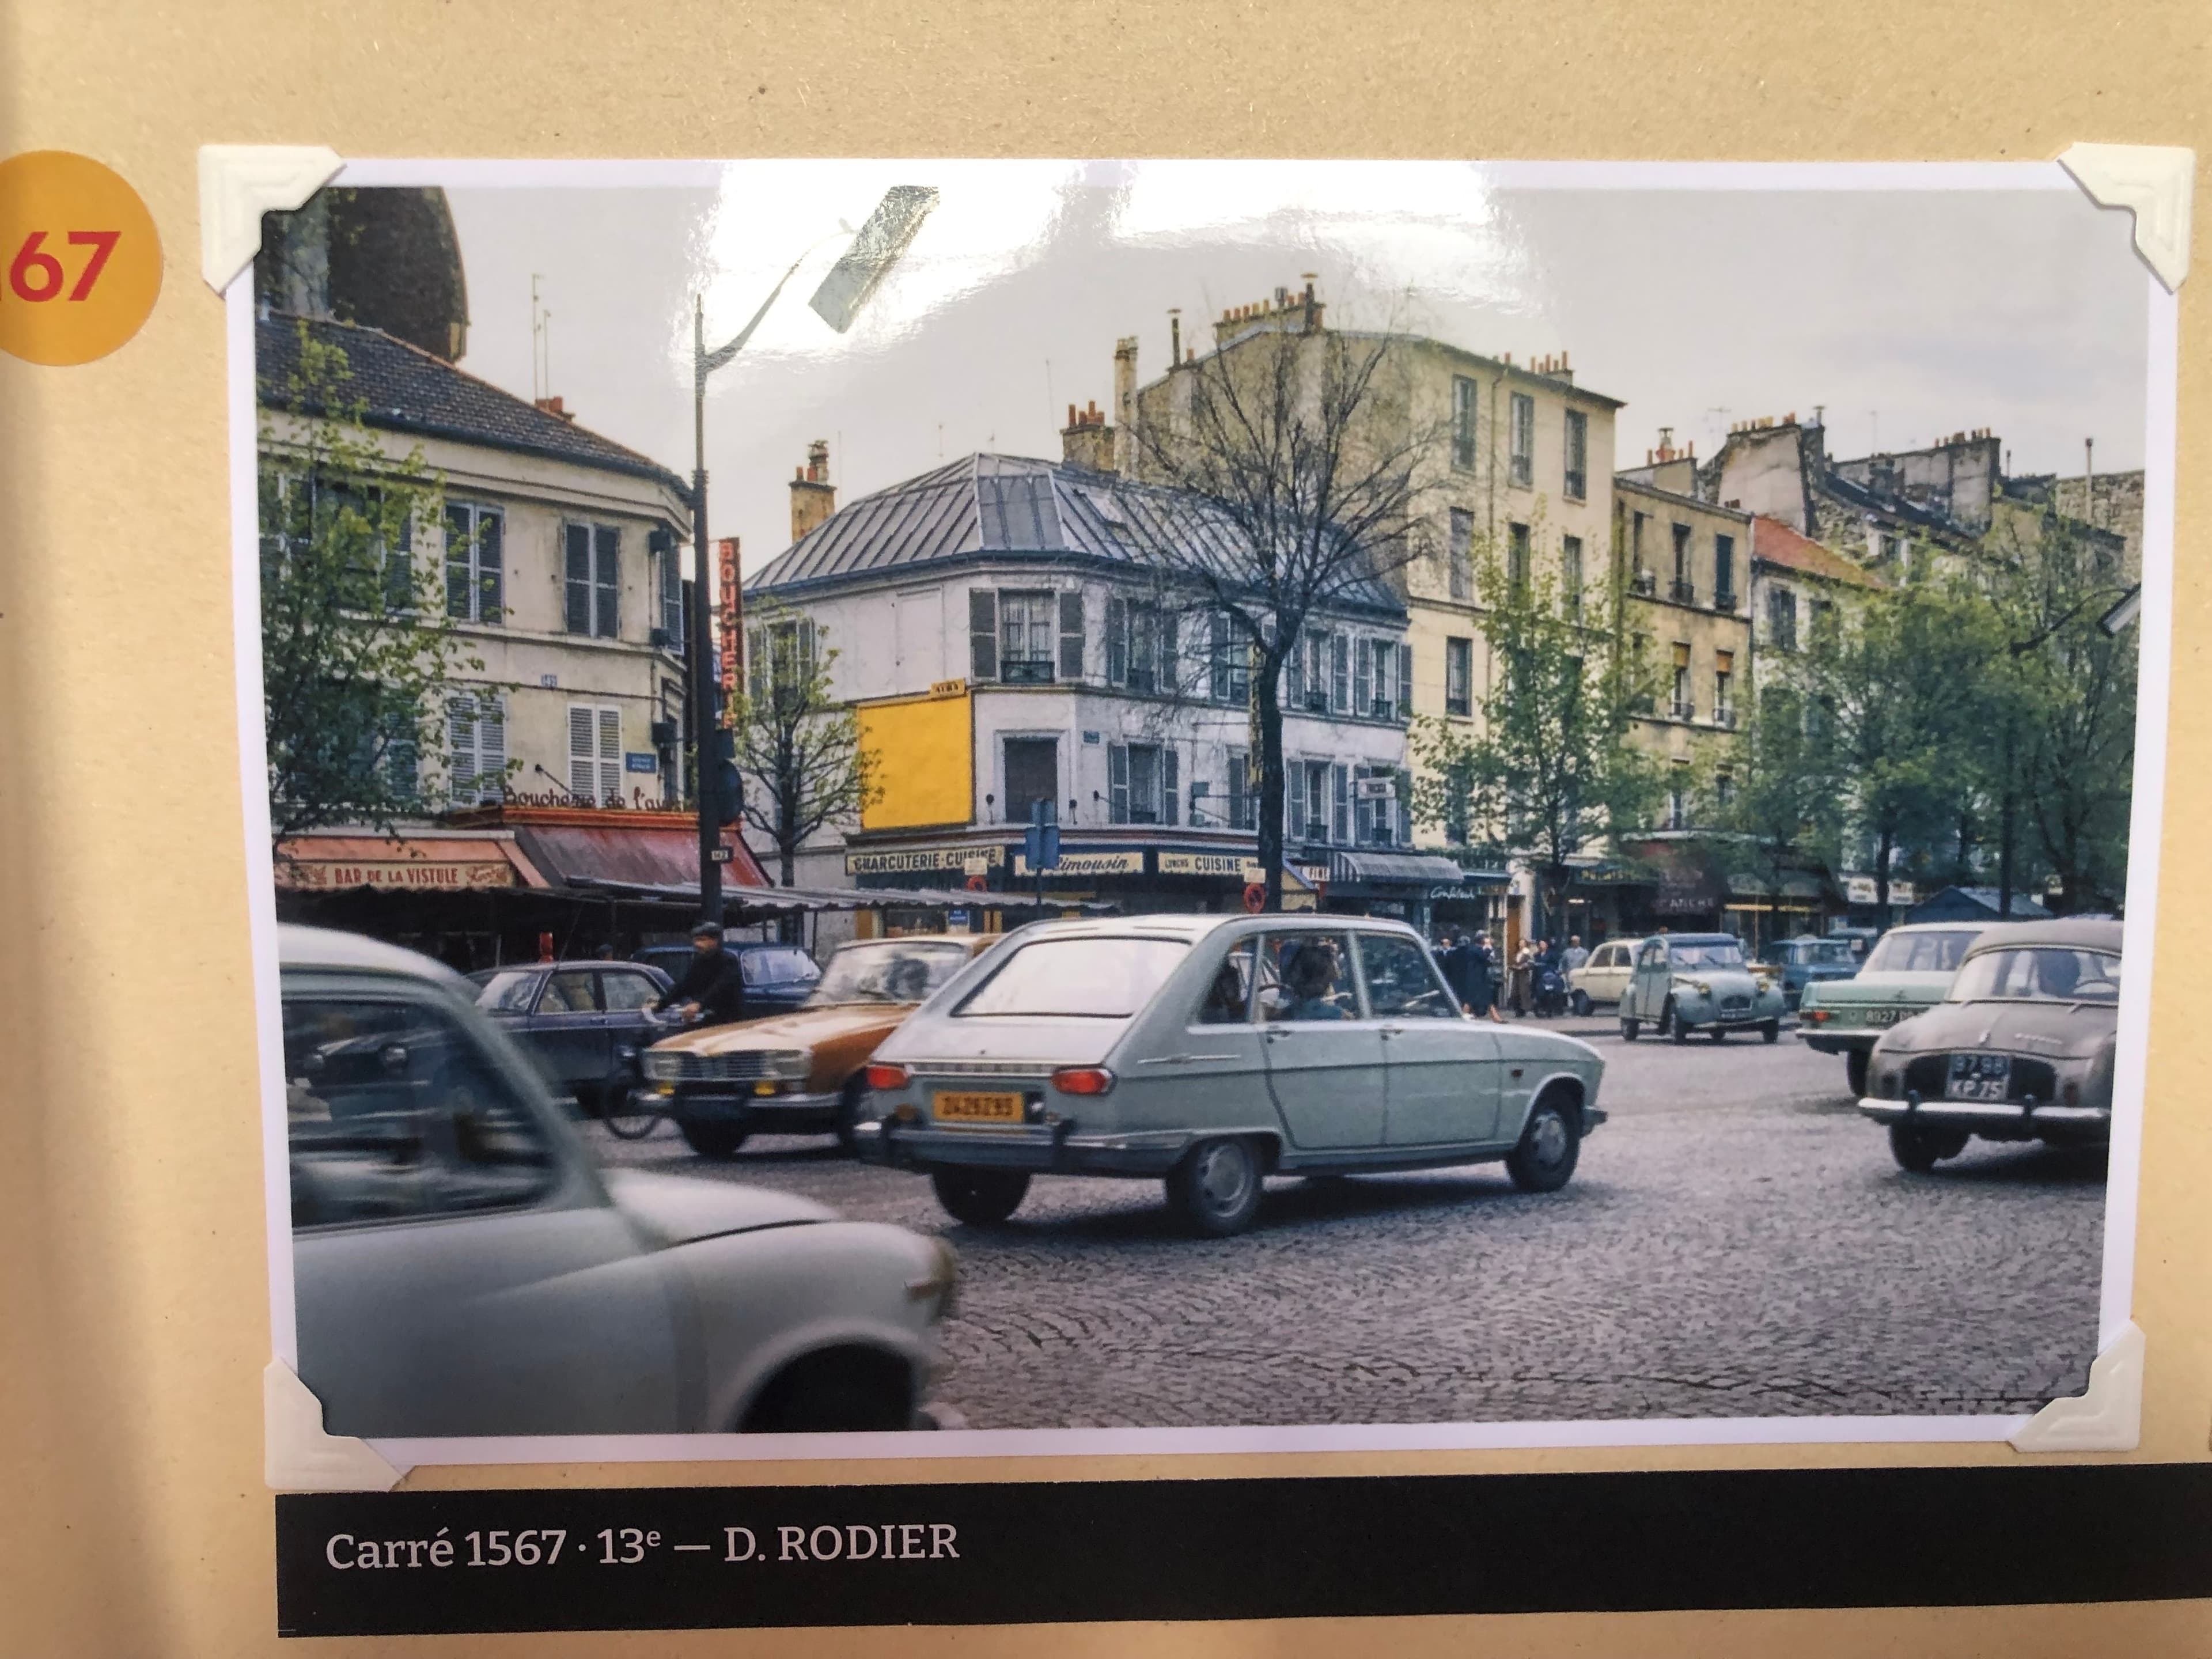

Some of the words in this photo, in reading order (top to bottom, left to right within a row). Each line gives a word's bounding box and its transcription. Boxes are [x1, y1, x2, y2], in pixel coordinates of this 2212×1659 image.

[0, 231, 122, 302] 67
[855, 853, 940, 872] CHARCUTERIE
[1059, 855, 1128, 871] imousin
[1195, 857, 1240, 872] CUISINE
[335, 868, 361, 884] BAR
[368, 870, 381, 882] DE
[388, 870, 403, 882] LA
[406, 868, 457, 884] VISTULE
[326, 1527, 454, 1569] Carré
[464, 1529, 567, 1566] 1567
[724, 1527, 766, 1562] D.
[778, 1524, 960, 1560] RODIER
